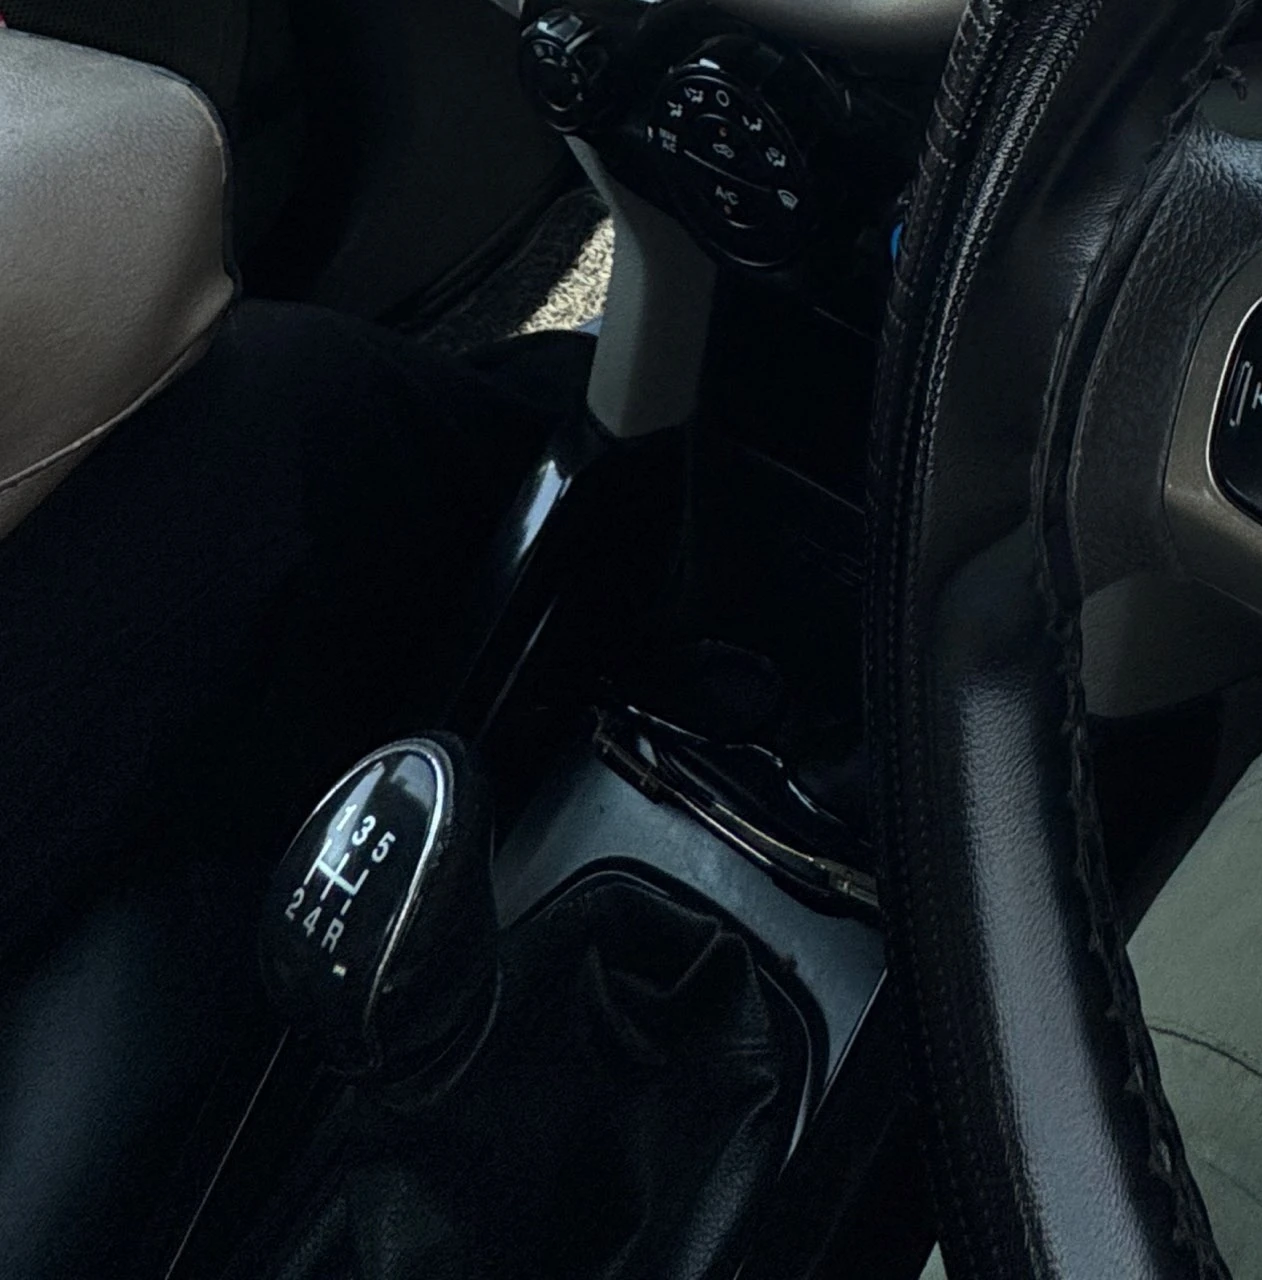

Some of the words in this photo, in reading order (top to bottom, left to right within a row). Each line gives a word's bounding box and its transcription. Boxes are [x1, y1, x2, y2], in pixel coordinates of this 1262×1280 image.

[336, 804, 357, 831] 1
[351, 814, 377, 846] 3
[371, 831, 396, 863] 5
[284, 887, 305, 922] 2
[302, 906, 322, 937] 4
[321, 918, 344, 953] R
